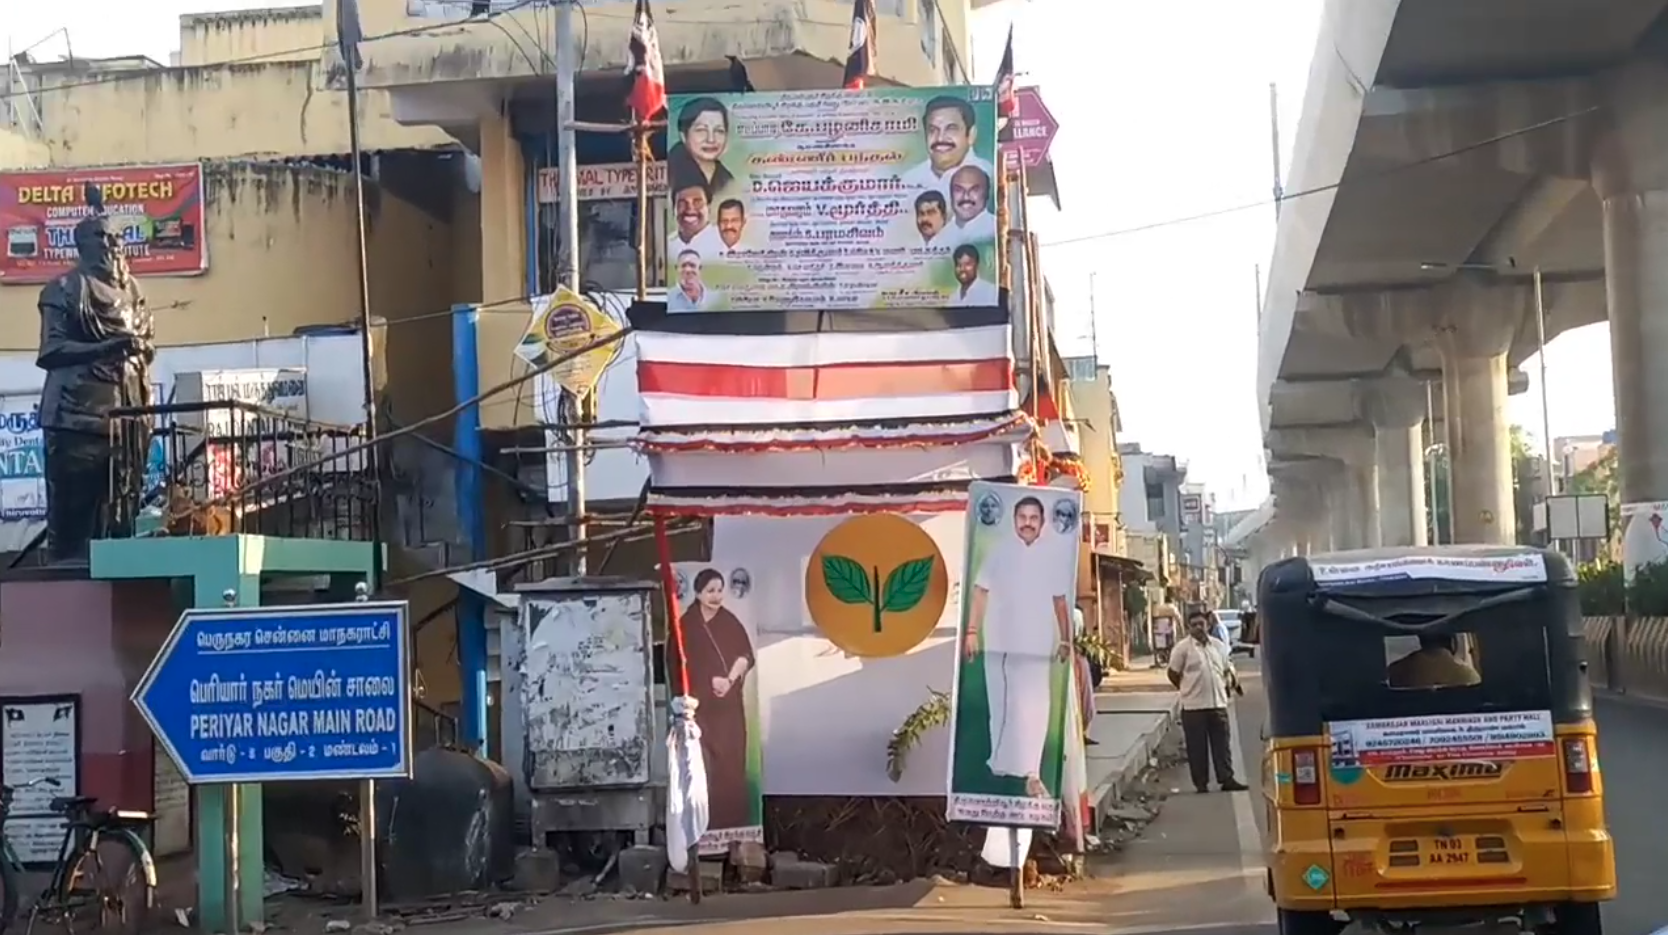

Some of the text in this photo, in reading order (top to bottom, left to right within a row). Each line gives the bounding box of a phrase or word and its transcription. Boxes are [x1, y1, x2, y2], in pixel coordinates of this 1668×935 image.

[540, 170, 603, 188] THMAL
[607, 167, 665, 184] TYPERIT
[18, 181, 173, 203] DELTA IFOTECH
[46, 204, 144, 218] COMPUTER DUCATION
[44, 224, 146, 247] THAL
[255, 625, 317, 644] சென்னை
[320, 621, 391, 643] மாநகராட்சி
[190, 670, 395, 709] பெரியார் நகர் மெயின் சாலை
[190, 707, 396, 739] PERIYAR NAGAR MAIN ROAD
[201, 742, 236, 764] வார்டு
[264, 741, 296, 763] பகுதி
[309, 747, 316, 758] 2
[324, 738, 379, 758] மண்டலம்
[391, 744, 396, 756] 1
[1434, 839, 1447, 850] TN
